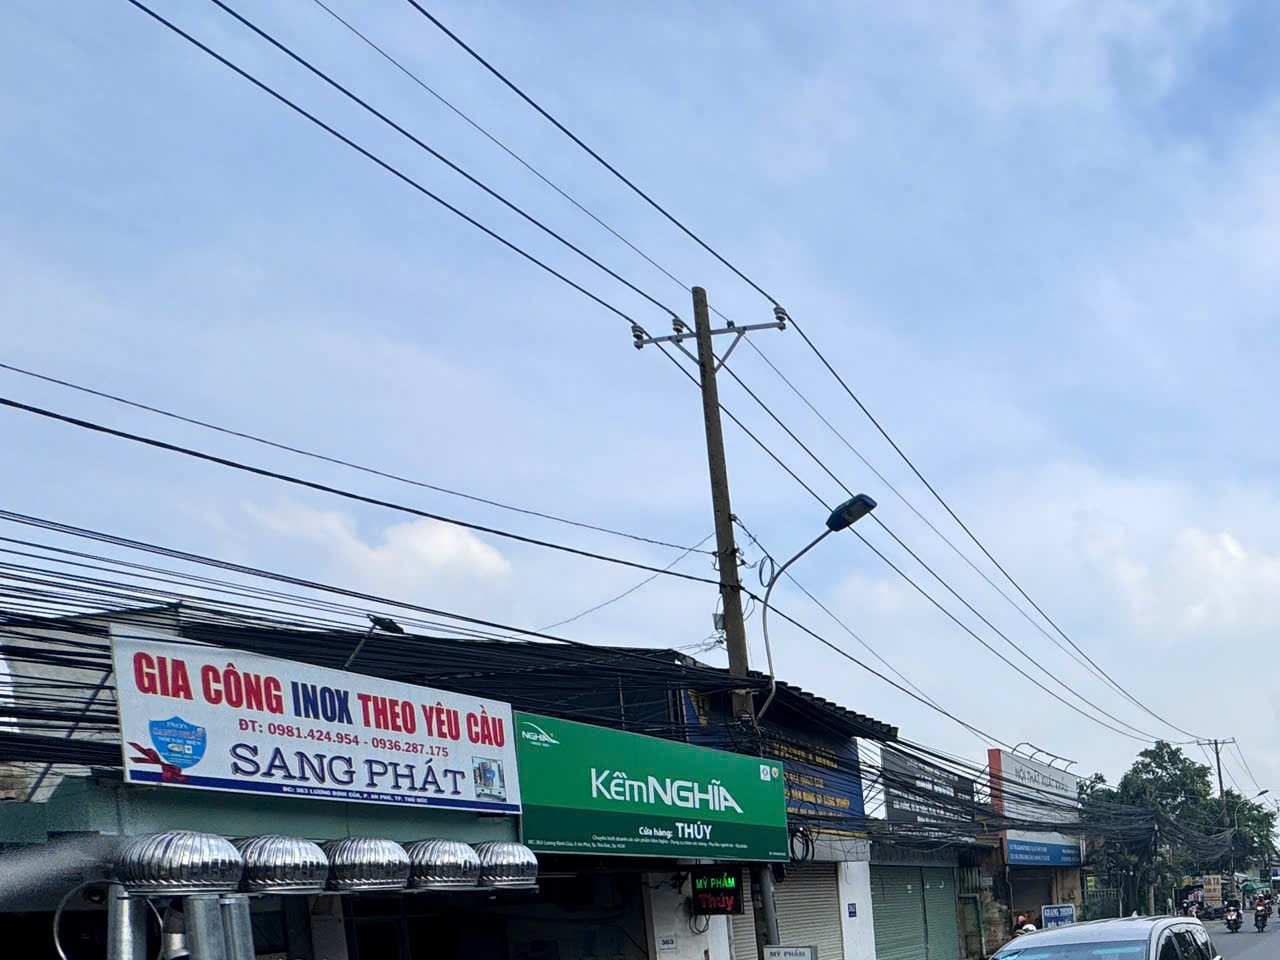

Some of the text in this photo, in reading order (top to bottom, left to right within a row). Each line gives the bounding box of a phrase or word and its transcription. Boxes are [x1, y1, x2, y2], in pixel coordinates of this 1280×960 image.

[133, 651, 505, 748] GIA CÔNG INOX THEO YÊU CẦU
[239, 718, 264, 734] ĐT:
[268, 722, 360, 747] 0981.424.954
[371, 737, 449, 758] 0936.287.175
[230, 742, 466, 796] SANG PHÁT
[675, 820, 713, 840] THÚY
